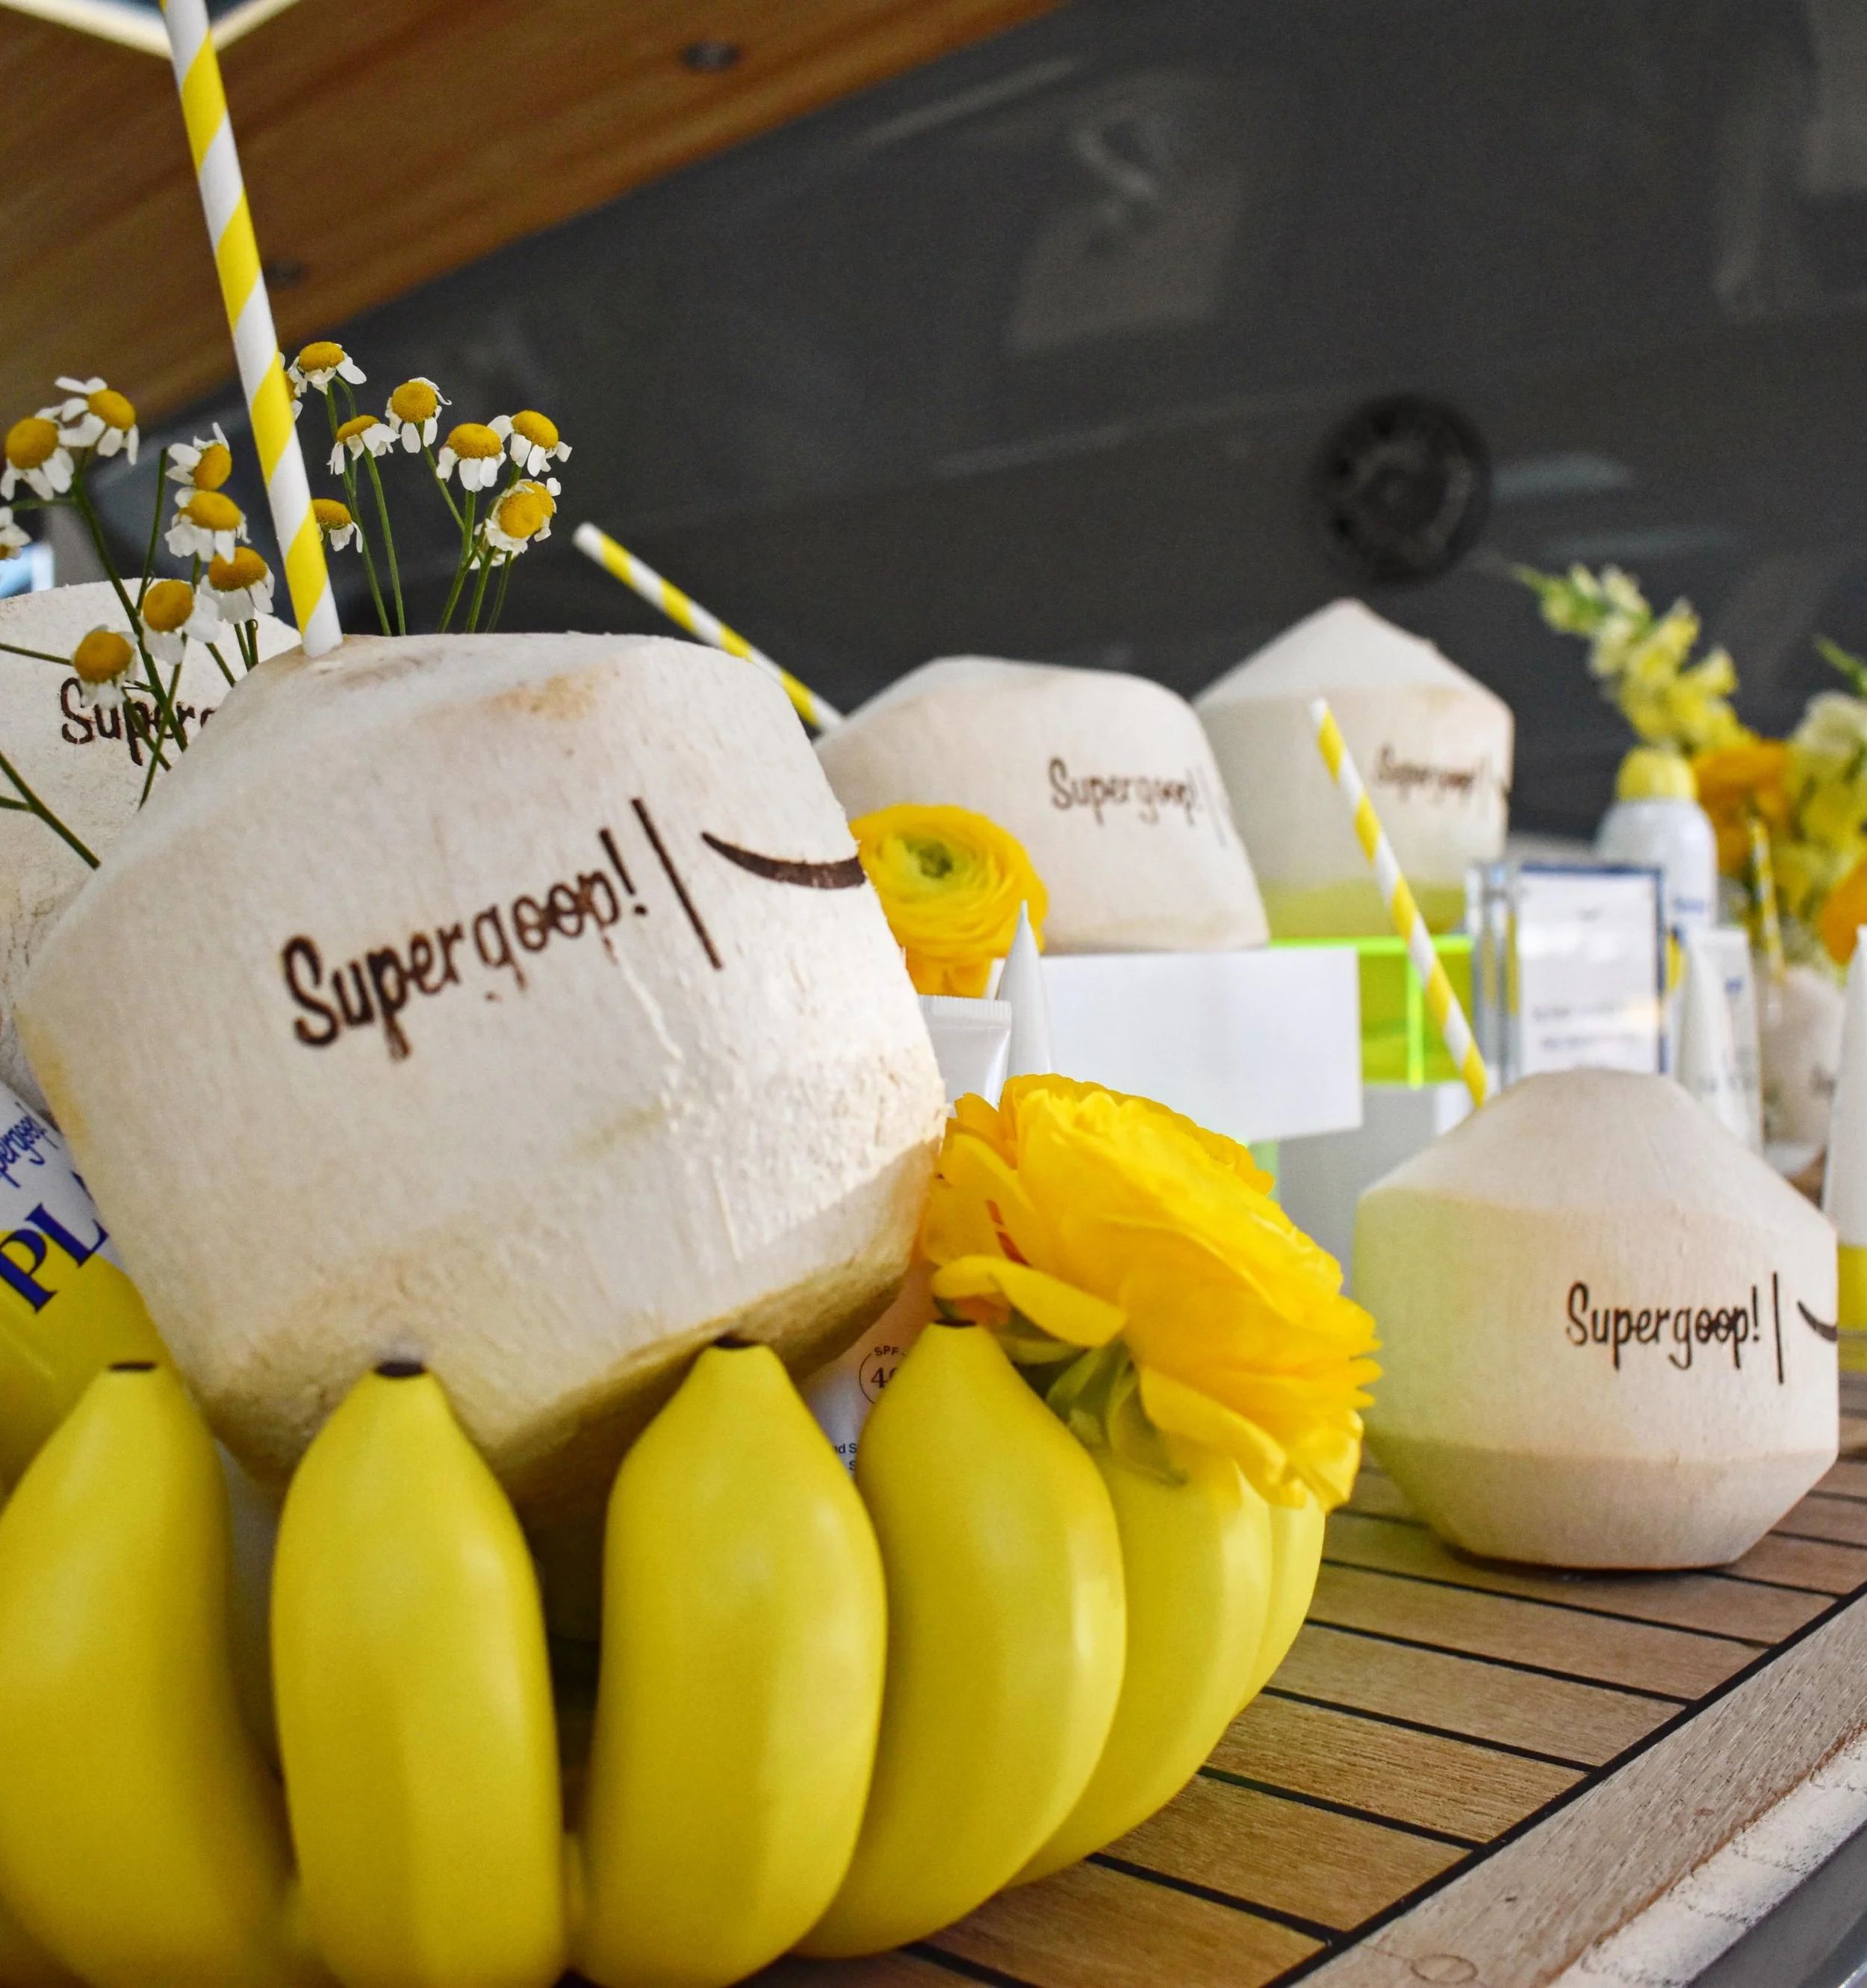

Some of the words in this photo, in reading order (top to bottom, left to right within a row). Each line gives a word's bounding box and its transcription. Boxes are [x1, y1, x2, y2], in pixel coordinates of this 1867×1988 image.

[279, 827, 648, 1061] Supergoop!
[874, 1345, 900, 1357] SPF
[1566, 1279, 1761, 1371] Supergoop!
[870, 1367, 900, 1389] 4
